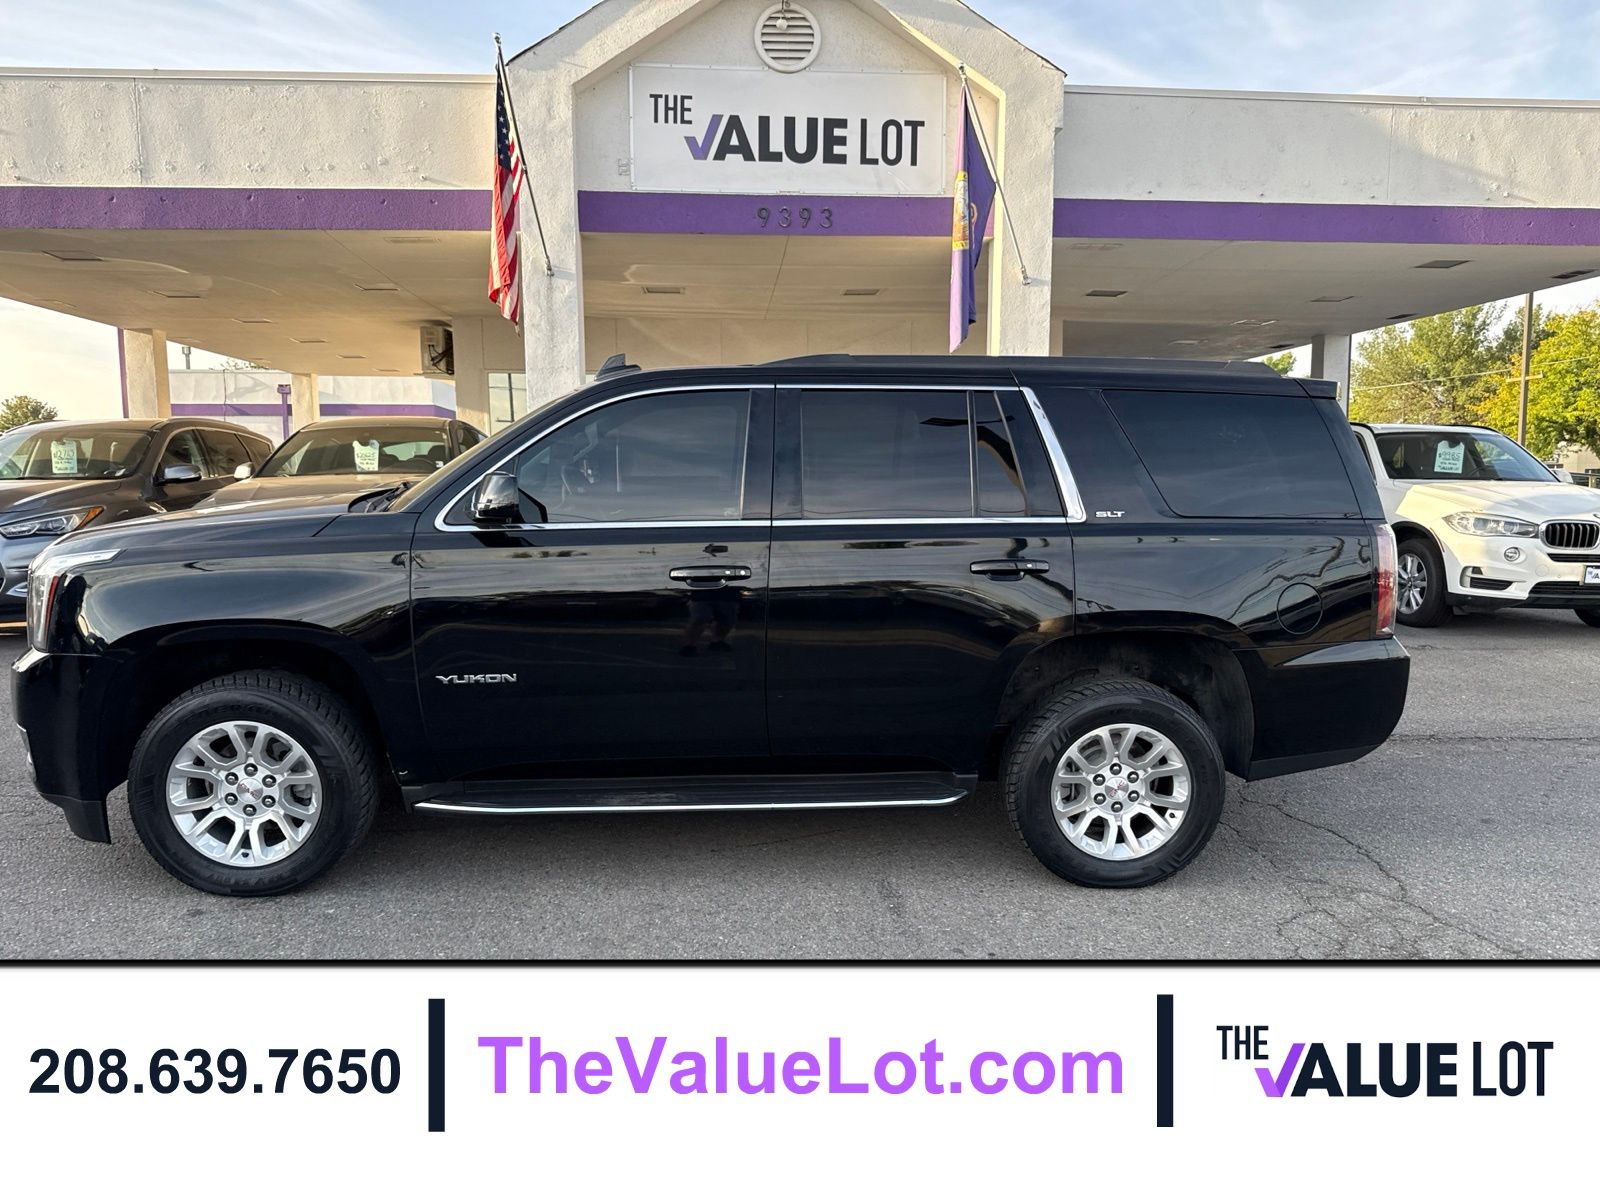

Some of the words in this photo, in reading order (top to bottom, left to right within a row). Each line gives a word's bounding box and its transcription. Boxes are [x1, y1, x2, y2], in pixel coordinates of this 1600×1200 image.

[650, 93, 693, 125] THE
[684, 113, 848, 165] VALUE
[860, 118, 925, 167] LOT
[757, 206, 834, 228] 9393
[1095, 510, 1125, 518] SLT
[435, 673, 517, 684] YUKON
